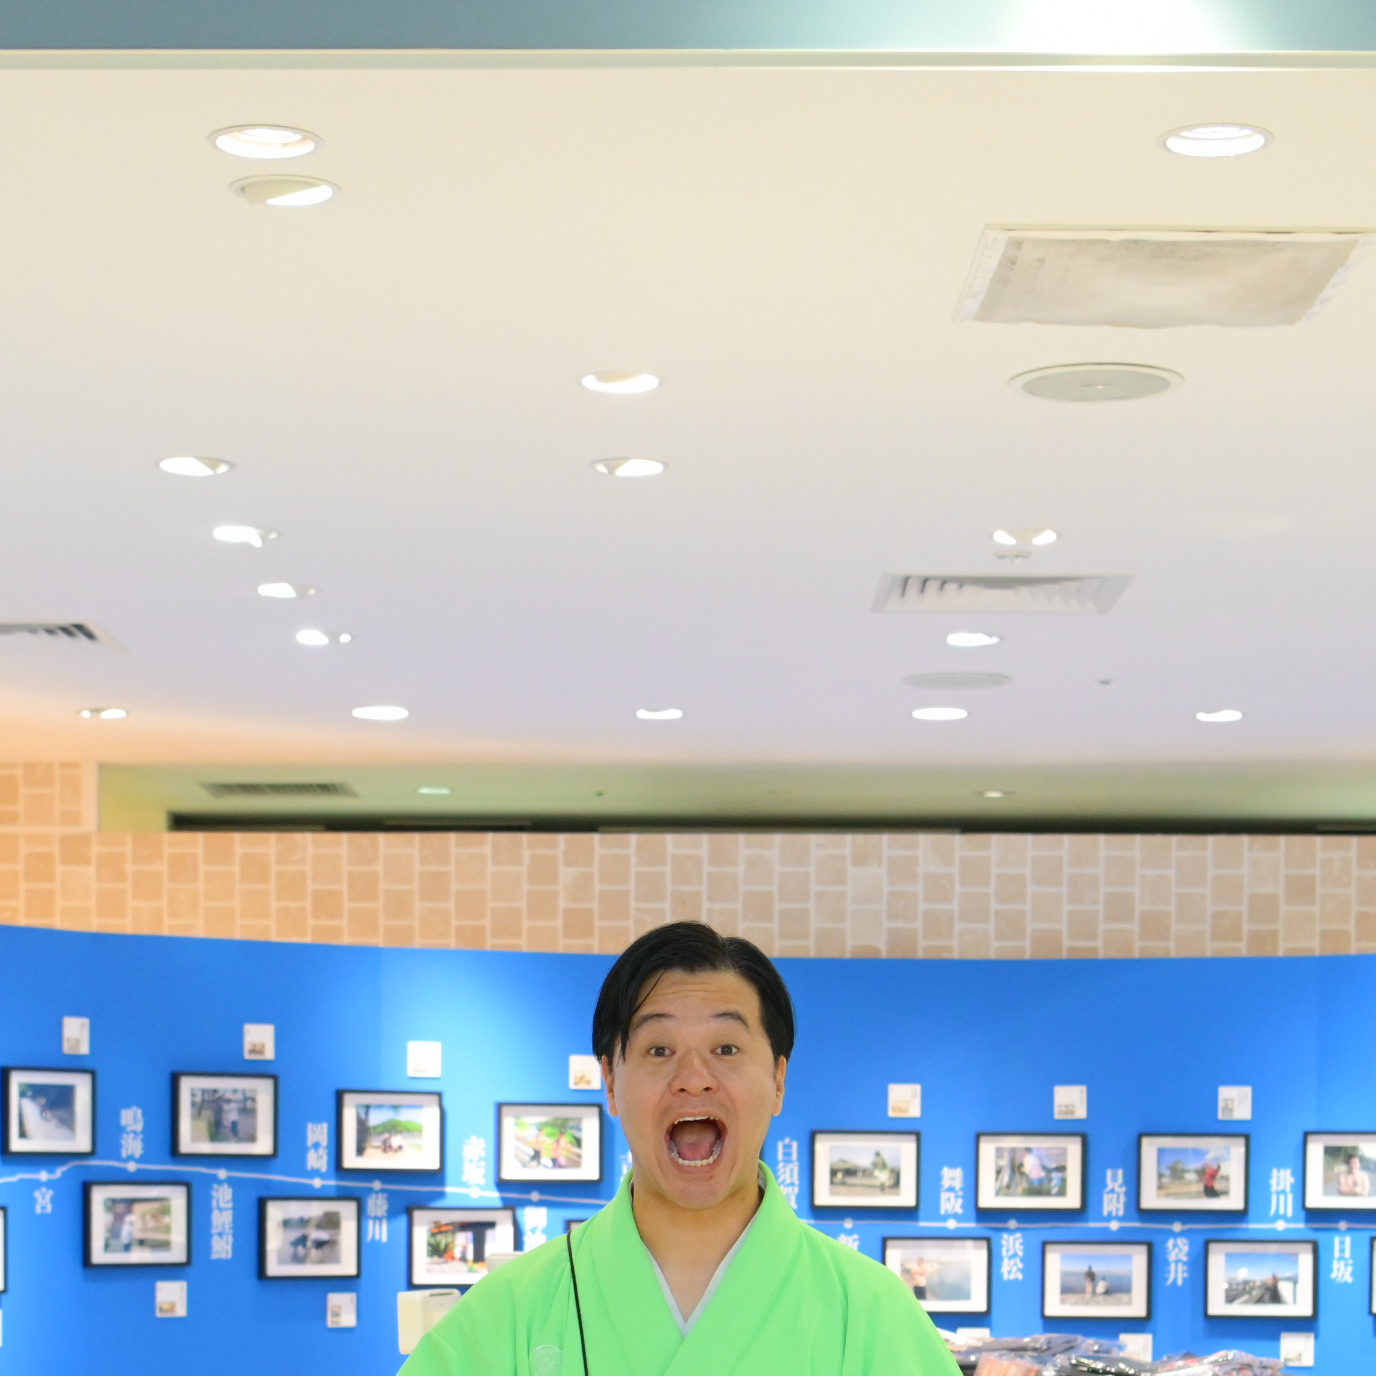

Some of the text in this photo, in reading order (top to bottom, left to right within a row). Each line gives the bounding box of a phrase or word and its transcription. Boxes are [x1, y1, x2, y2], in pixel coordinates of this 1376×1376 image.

[1103, 1168, 1127, 1217] 見附
[1269, 1168, 1295, 1218] 掛川
[1000, 1233, 1024, 1281] 浜松
[1165, 1237, 1189, 1287] 袋井
[1330, 1236, 1354, 1284] 日坂
